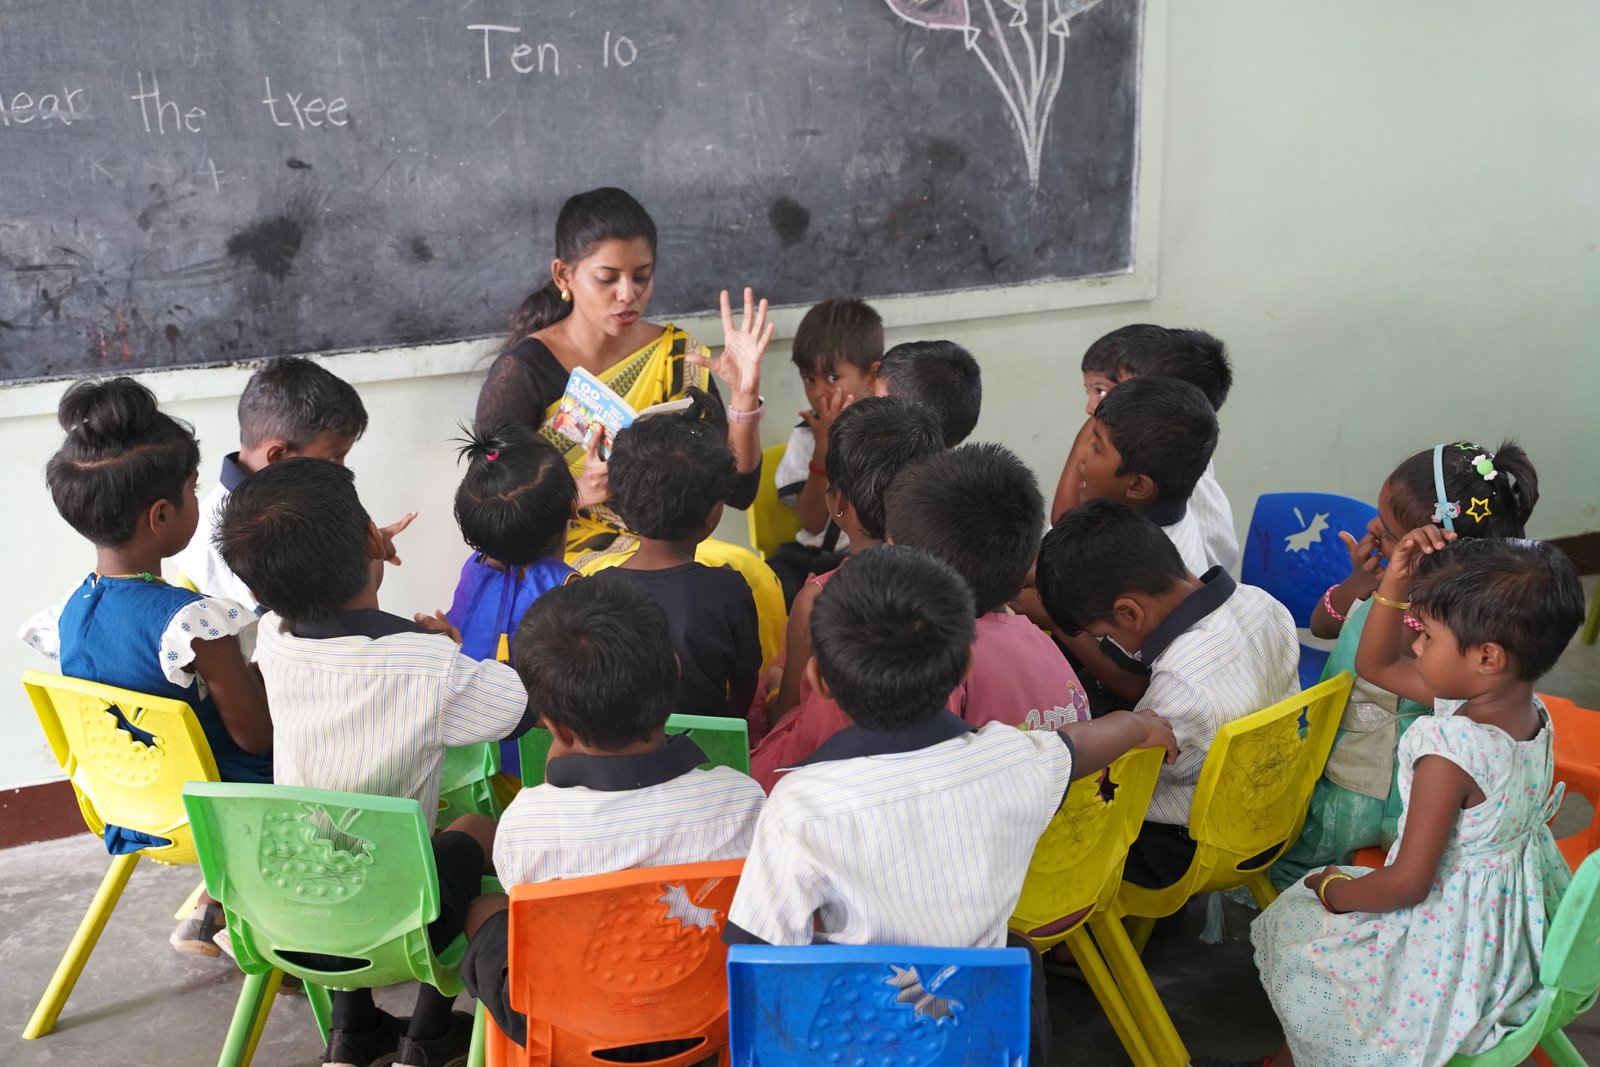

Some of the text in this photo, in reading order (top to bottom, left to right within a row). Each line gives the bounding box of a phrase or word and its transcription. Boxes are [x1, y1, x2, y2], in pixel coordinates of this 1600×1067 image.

[466, 23, 638, 79] Ten 10
[131, 67, 207, 134] the
[262, 75, 349, 130] tree
[573, 376, 601, 401] 100
